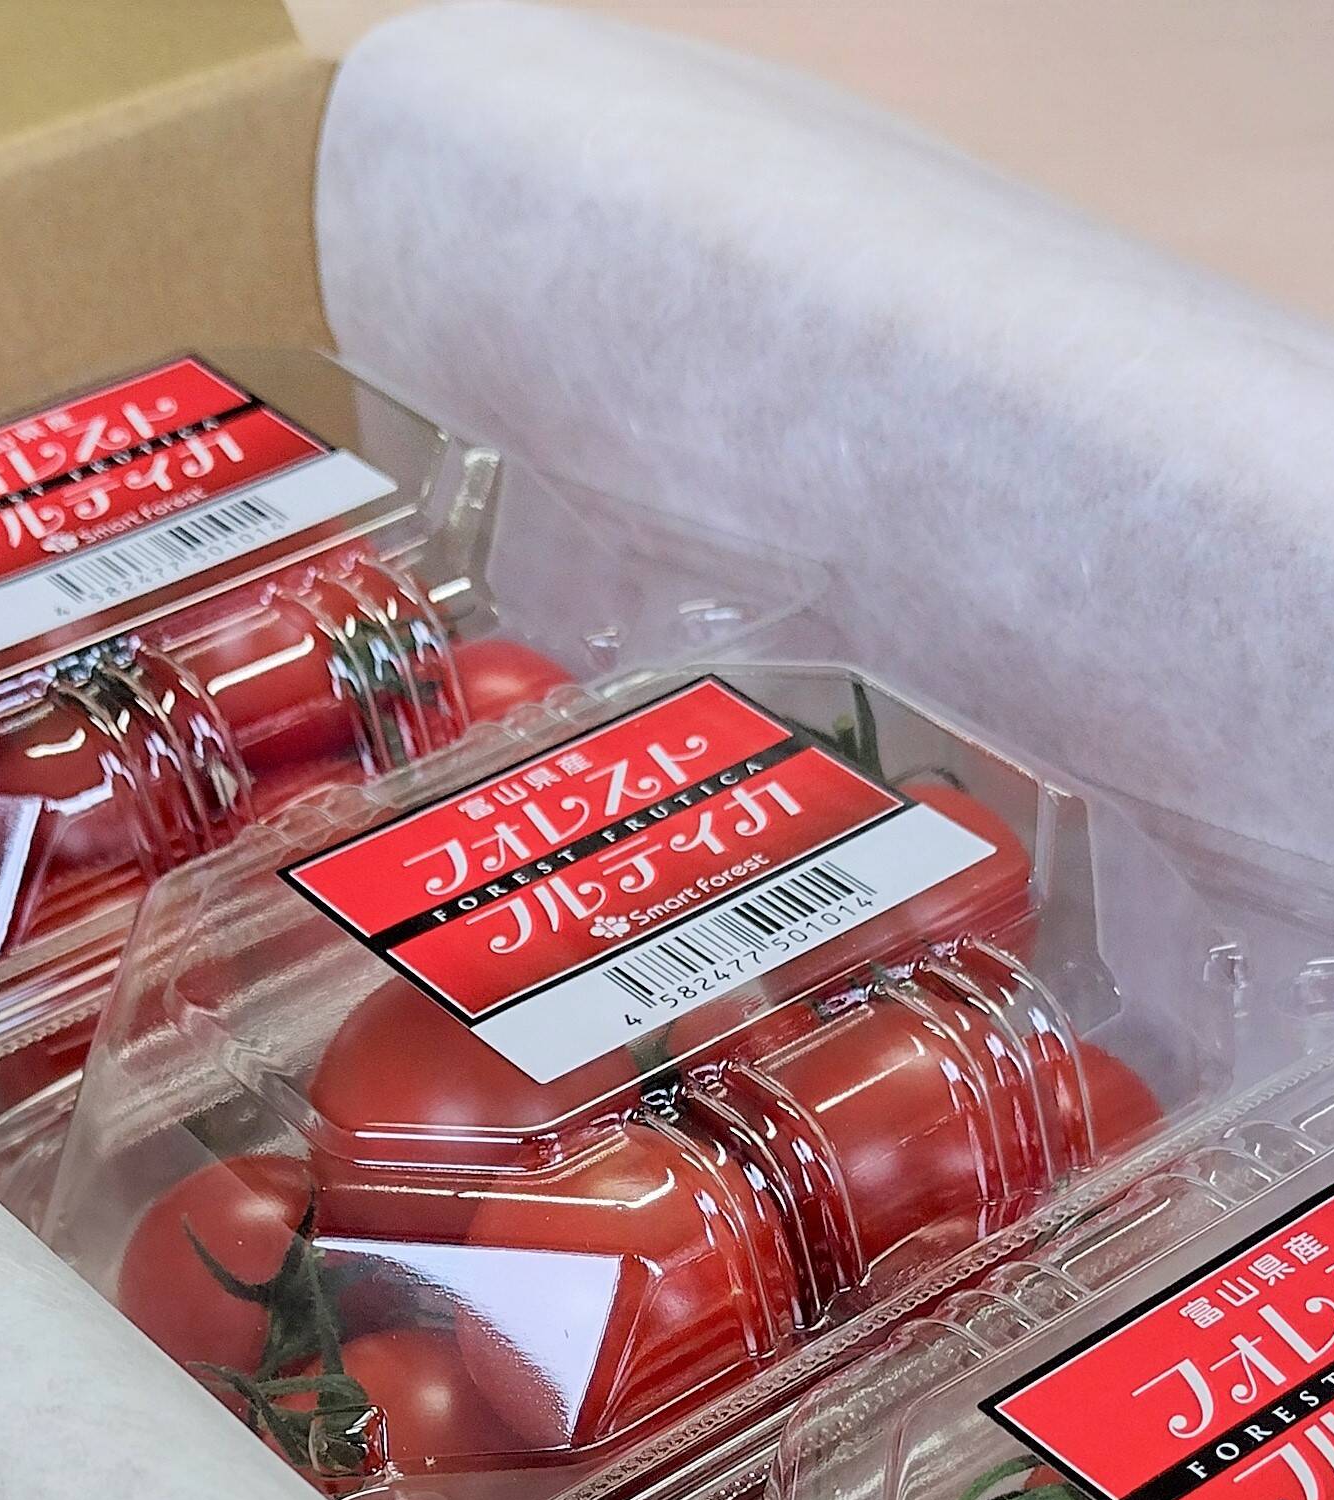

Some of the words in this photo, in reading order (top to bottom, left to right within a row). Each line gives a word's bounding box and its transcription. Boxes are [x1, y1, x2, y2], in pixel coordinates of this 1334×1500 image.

[78, 511, 145, 545] Smart
[402, 734, 708, 895] フォレスト
[457, 752, 593, 821] 富山県産
[432, 848, 577, 922] FOREST
[602, 760, 765, 843] FRUTICA
[466, 780, 804, 954] フルティカ
[629, 887, 701, 926] Smart
[624, 1013, 643, 1027] 4
[1178, 1231, 1330, 1329] 富山県産
